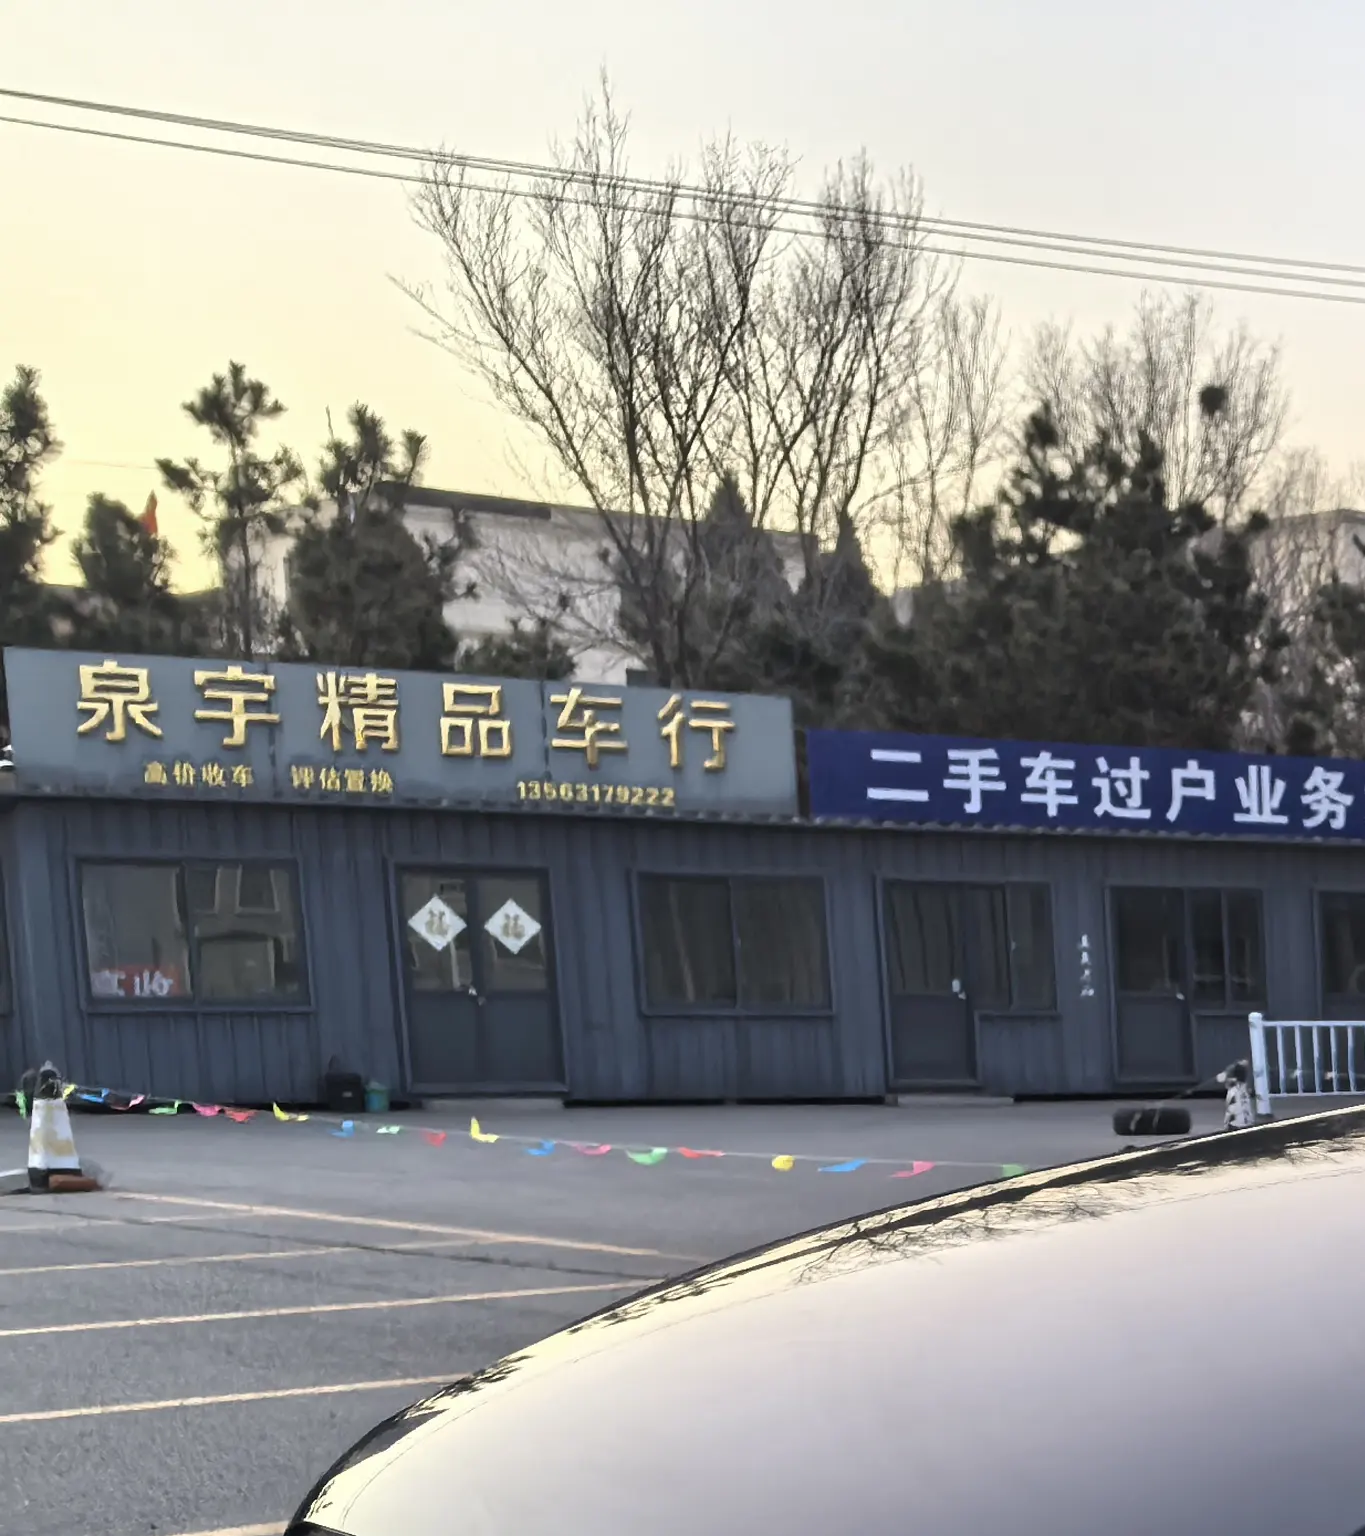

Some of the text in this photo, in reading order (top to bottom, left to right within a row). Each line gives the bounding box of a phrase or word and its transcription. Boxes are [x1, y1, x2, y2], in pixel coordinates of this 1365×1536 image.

[77, 659, 735, 769] 泉宇精品车行
[145, 760, 394, 792] 高价收车 评估置换
